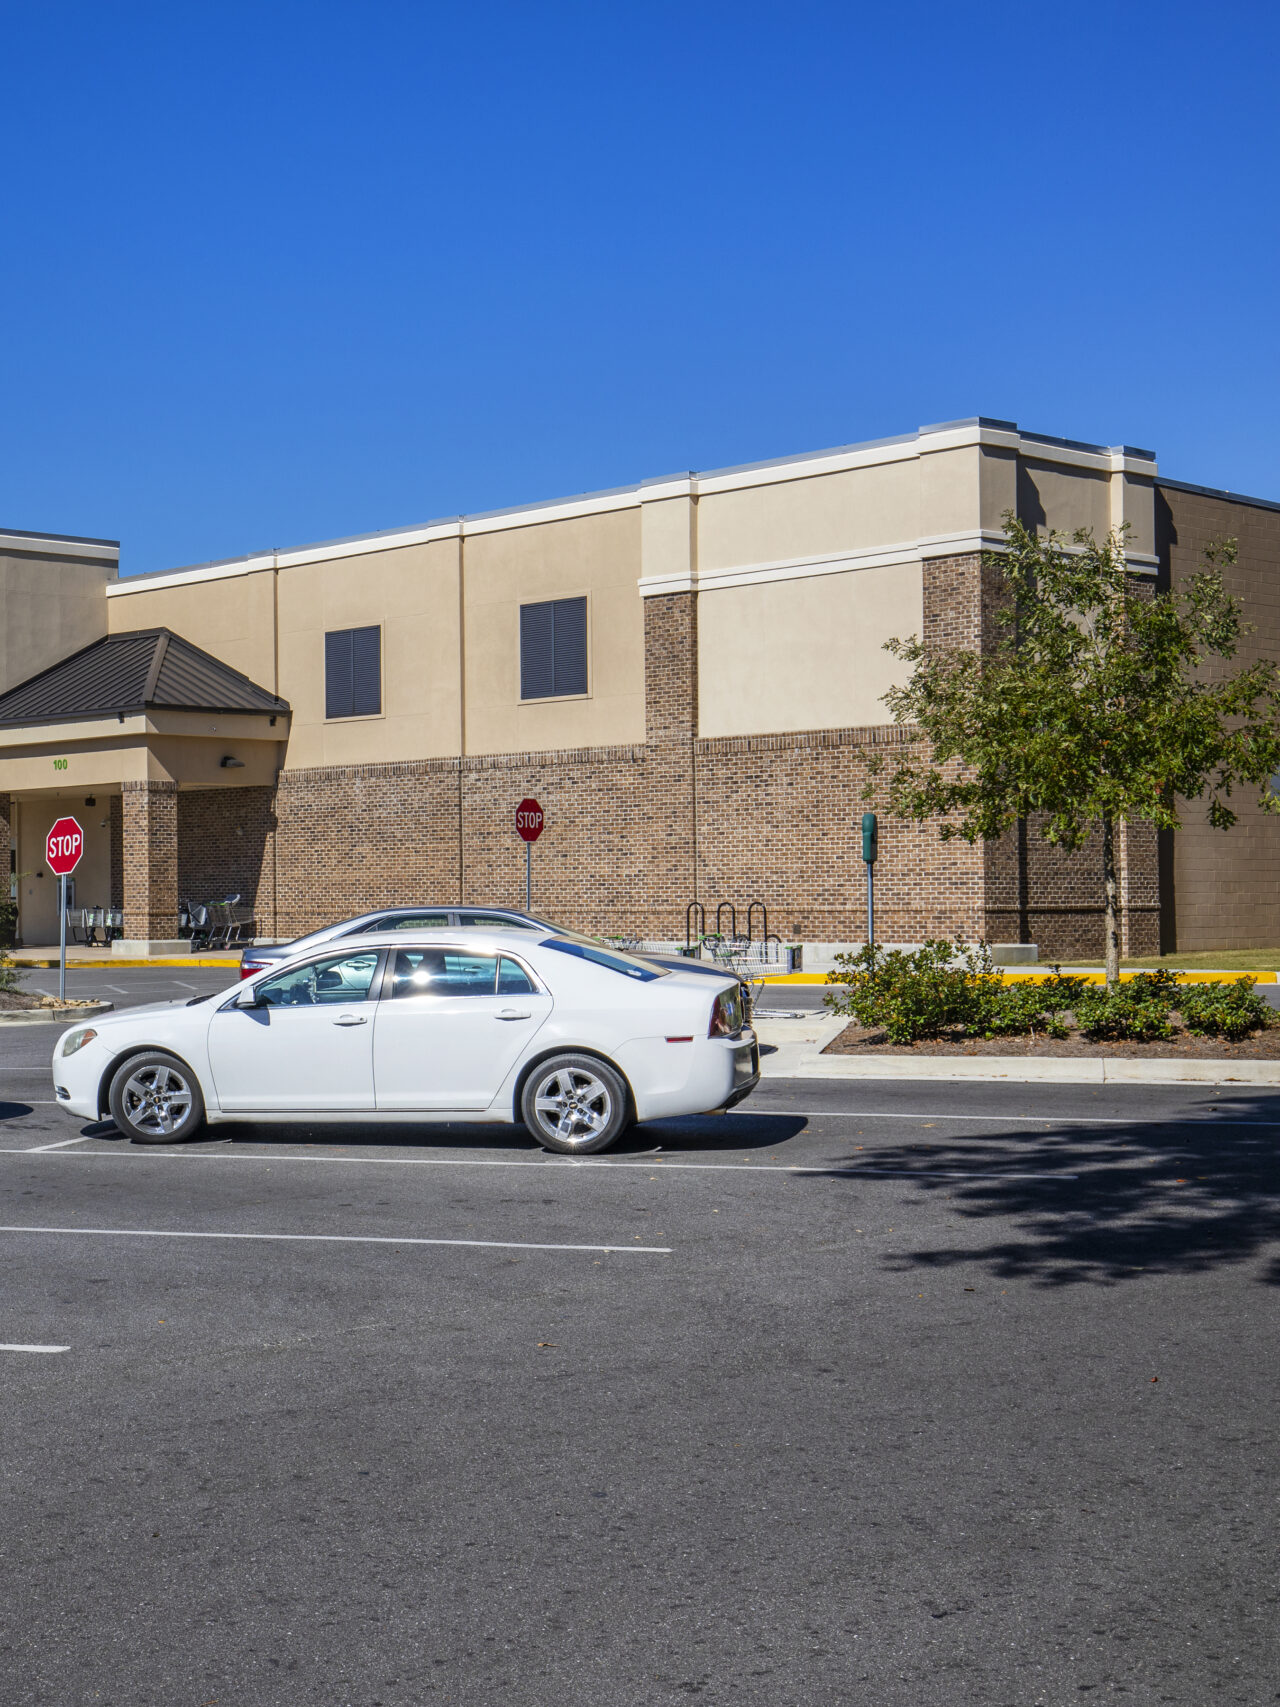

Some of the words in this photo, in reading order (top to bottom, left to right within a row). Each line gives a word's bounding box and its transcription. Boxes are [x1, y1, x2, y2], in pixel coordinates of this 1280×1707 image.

[53, 759, 68, 771] 100
[517, 811, 543, 829] STOP
[48, 833, 81, 858] STOP
